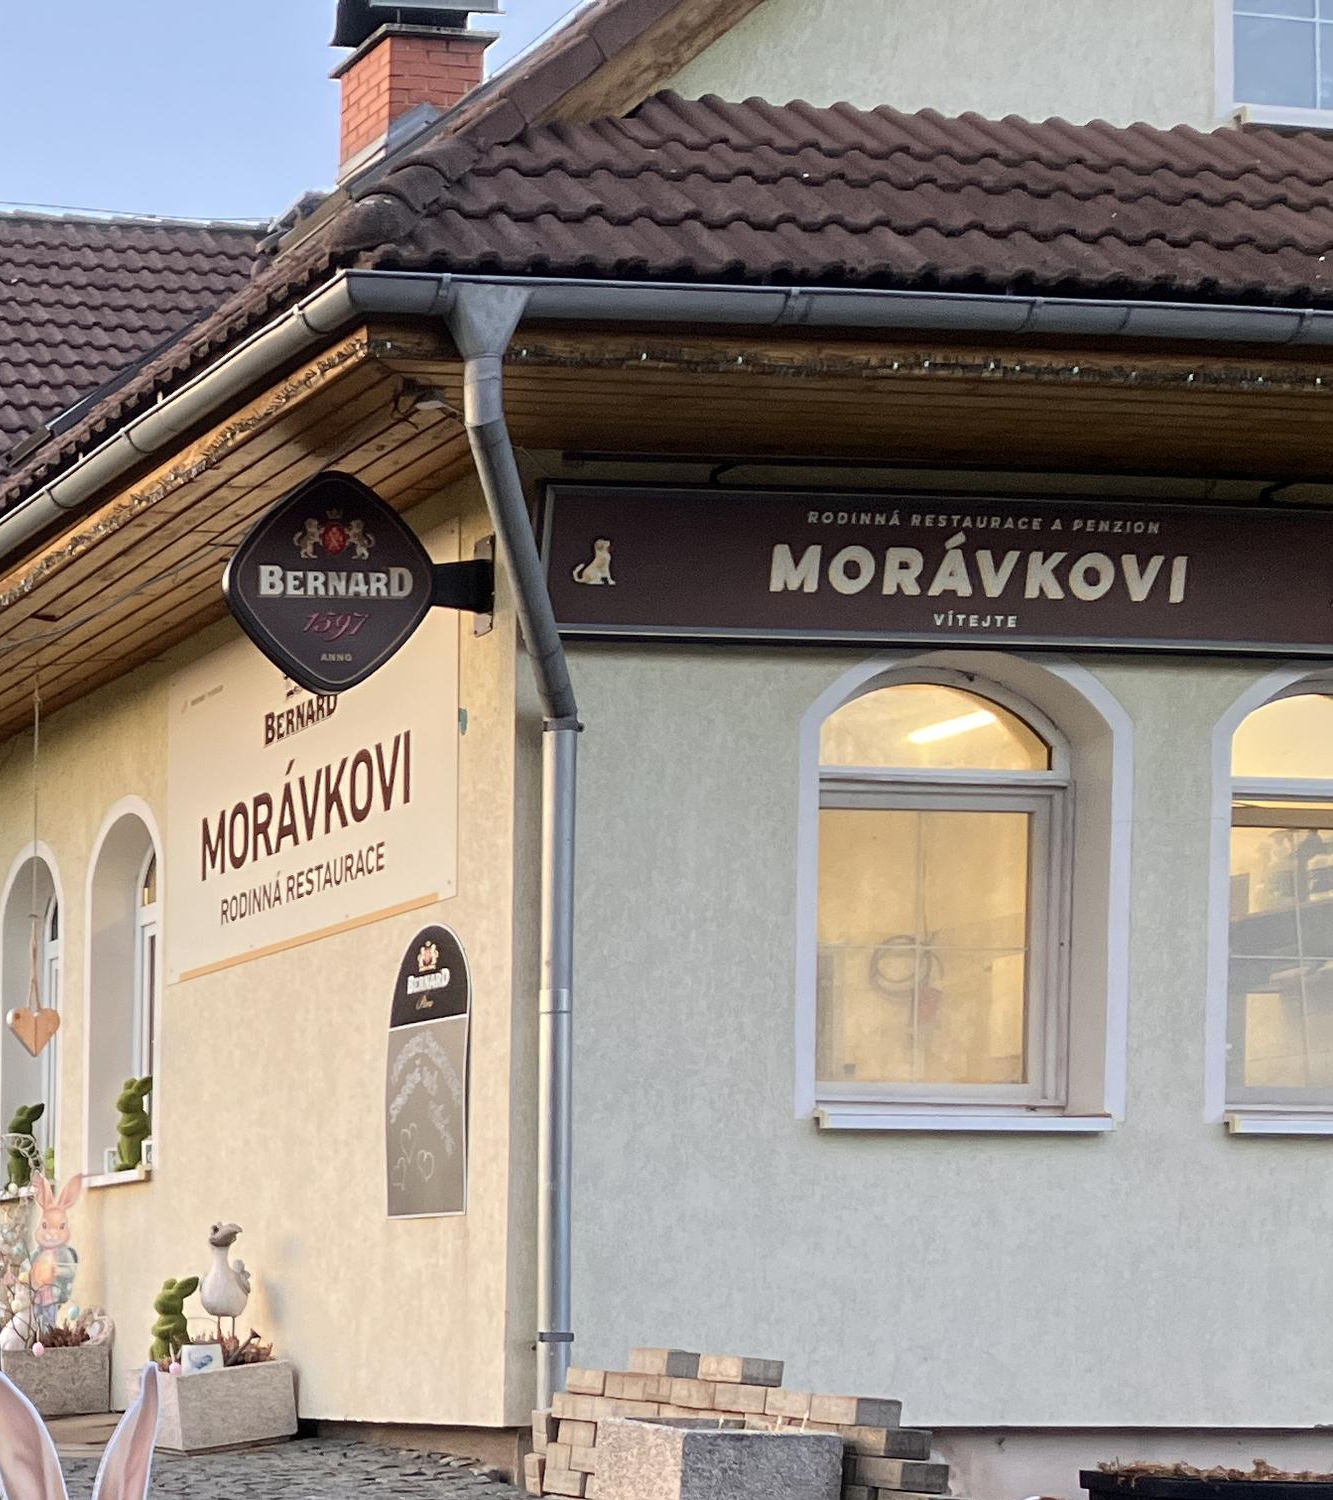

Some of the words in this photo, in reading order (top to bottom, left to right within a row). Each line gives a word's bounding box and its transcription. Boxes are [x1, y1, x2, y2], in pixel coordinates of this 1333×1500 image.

[807, 510, 901, 526] RODINNÁ
[910, 514, 1043, 531] RESTAURACE
[1051, 519, 1063, 530] A
[1073, 519, 1160, 534] PENZION
[258, 564, 414, 598] BERNARD
[769, 531, 1189, 604] MORÁVKOVI
[302, 611, 369, 642] 1597
[933, 610, 1017, 628] VÍTEJTE
[320, 653, 352, 662] ANNO
[263, 694, 337, 747] BERNARD
[201, 730, 411, 882] MORÁVKOVI
[220, 870, 283, 926] RODINNÁ
[285, 841, 386, 903] RESTAURACE
